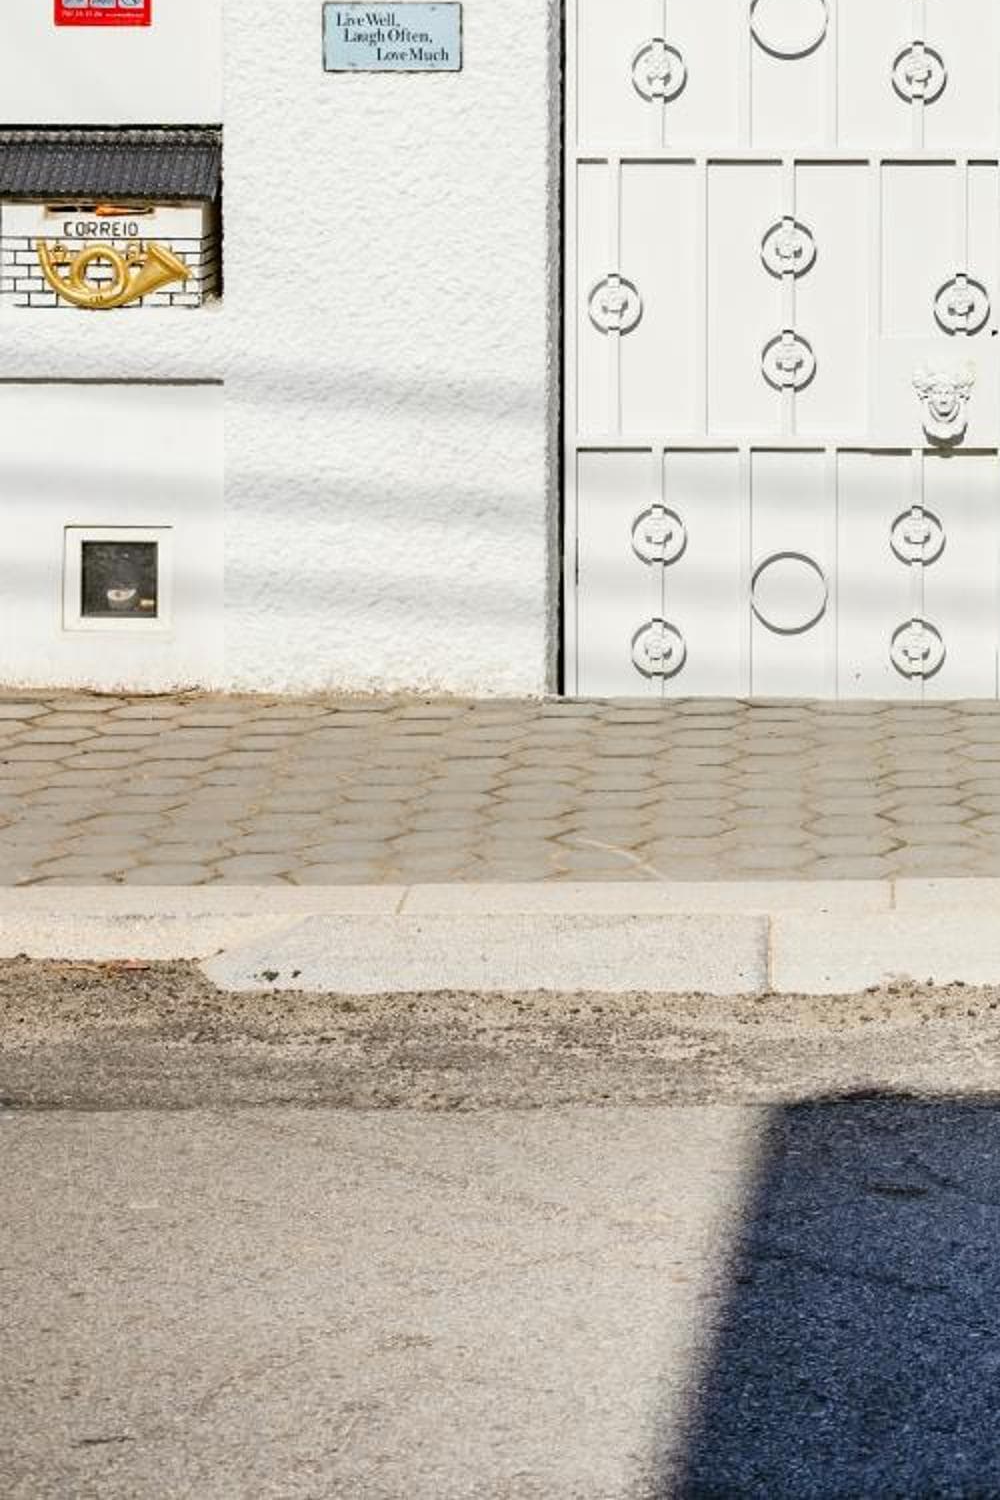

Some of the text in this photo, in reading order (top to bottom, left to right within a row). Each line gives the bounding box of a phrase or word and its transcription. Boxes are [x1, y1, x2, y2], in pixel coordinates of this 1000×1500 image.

[336, 12, 364, 27] Live
[344, 27, 433, 46] Laugh Often,
[377, 47, 449, 61] Love Much
[63, 221, 139, 237] CORREIO
